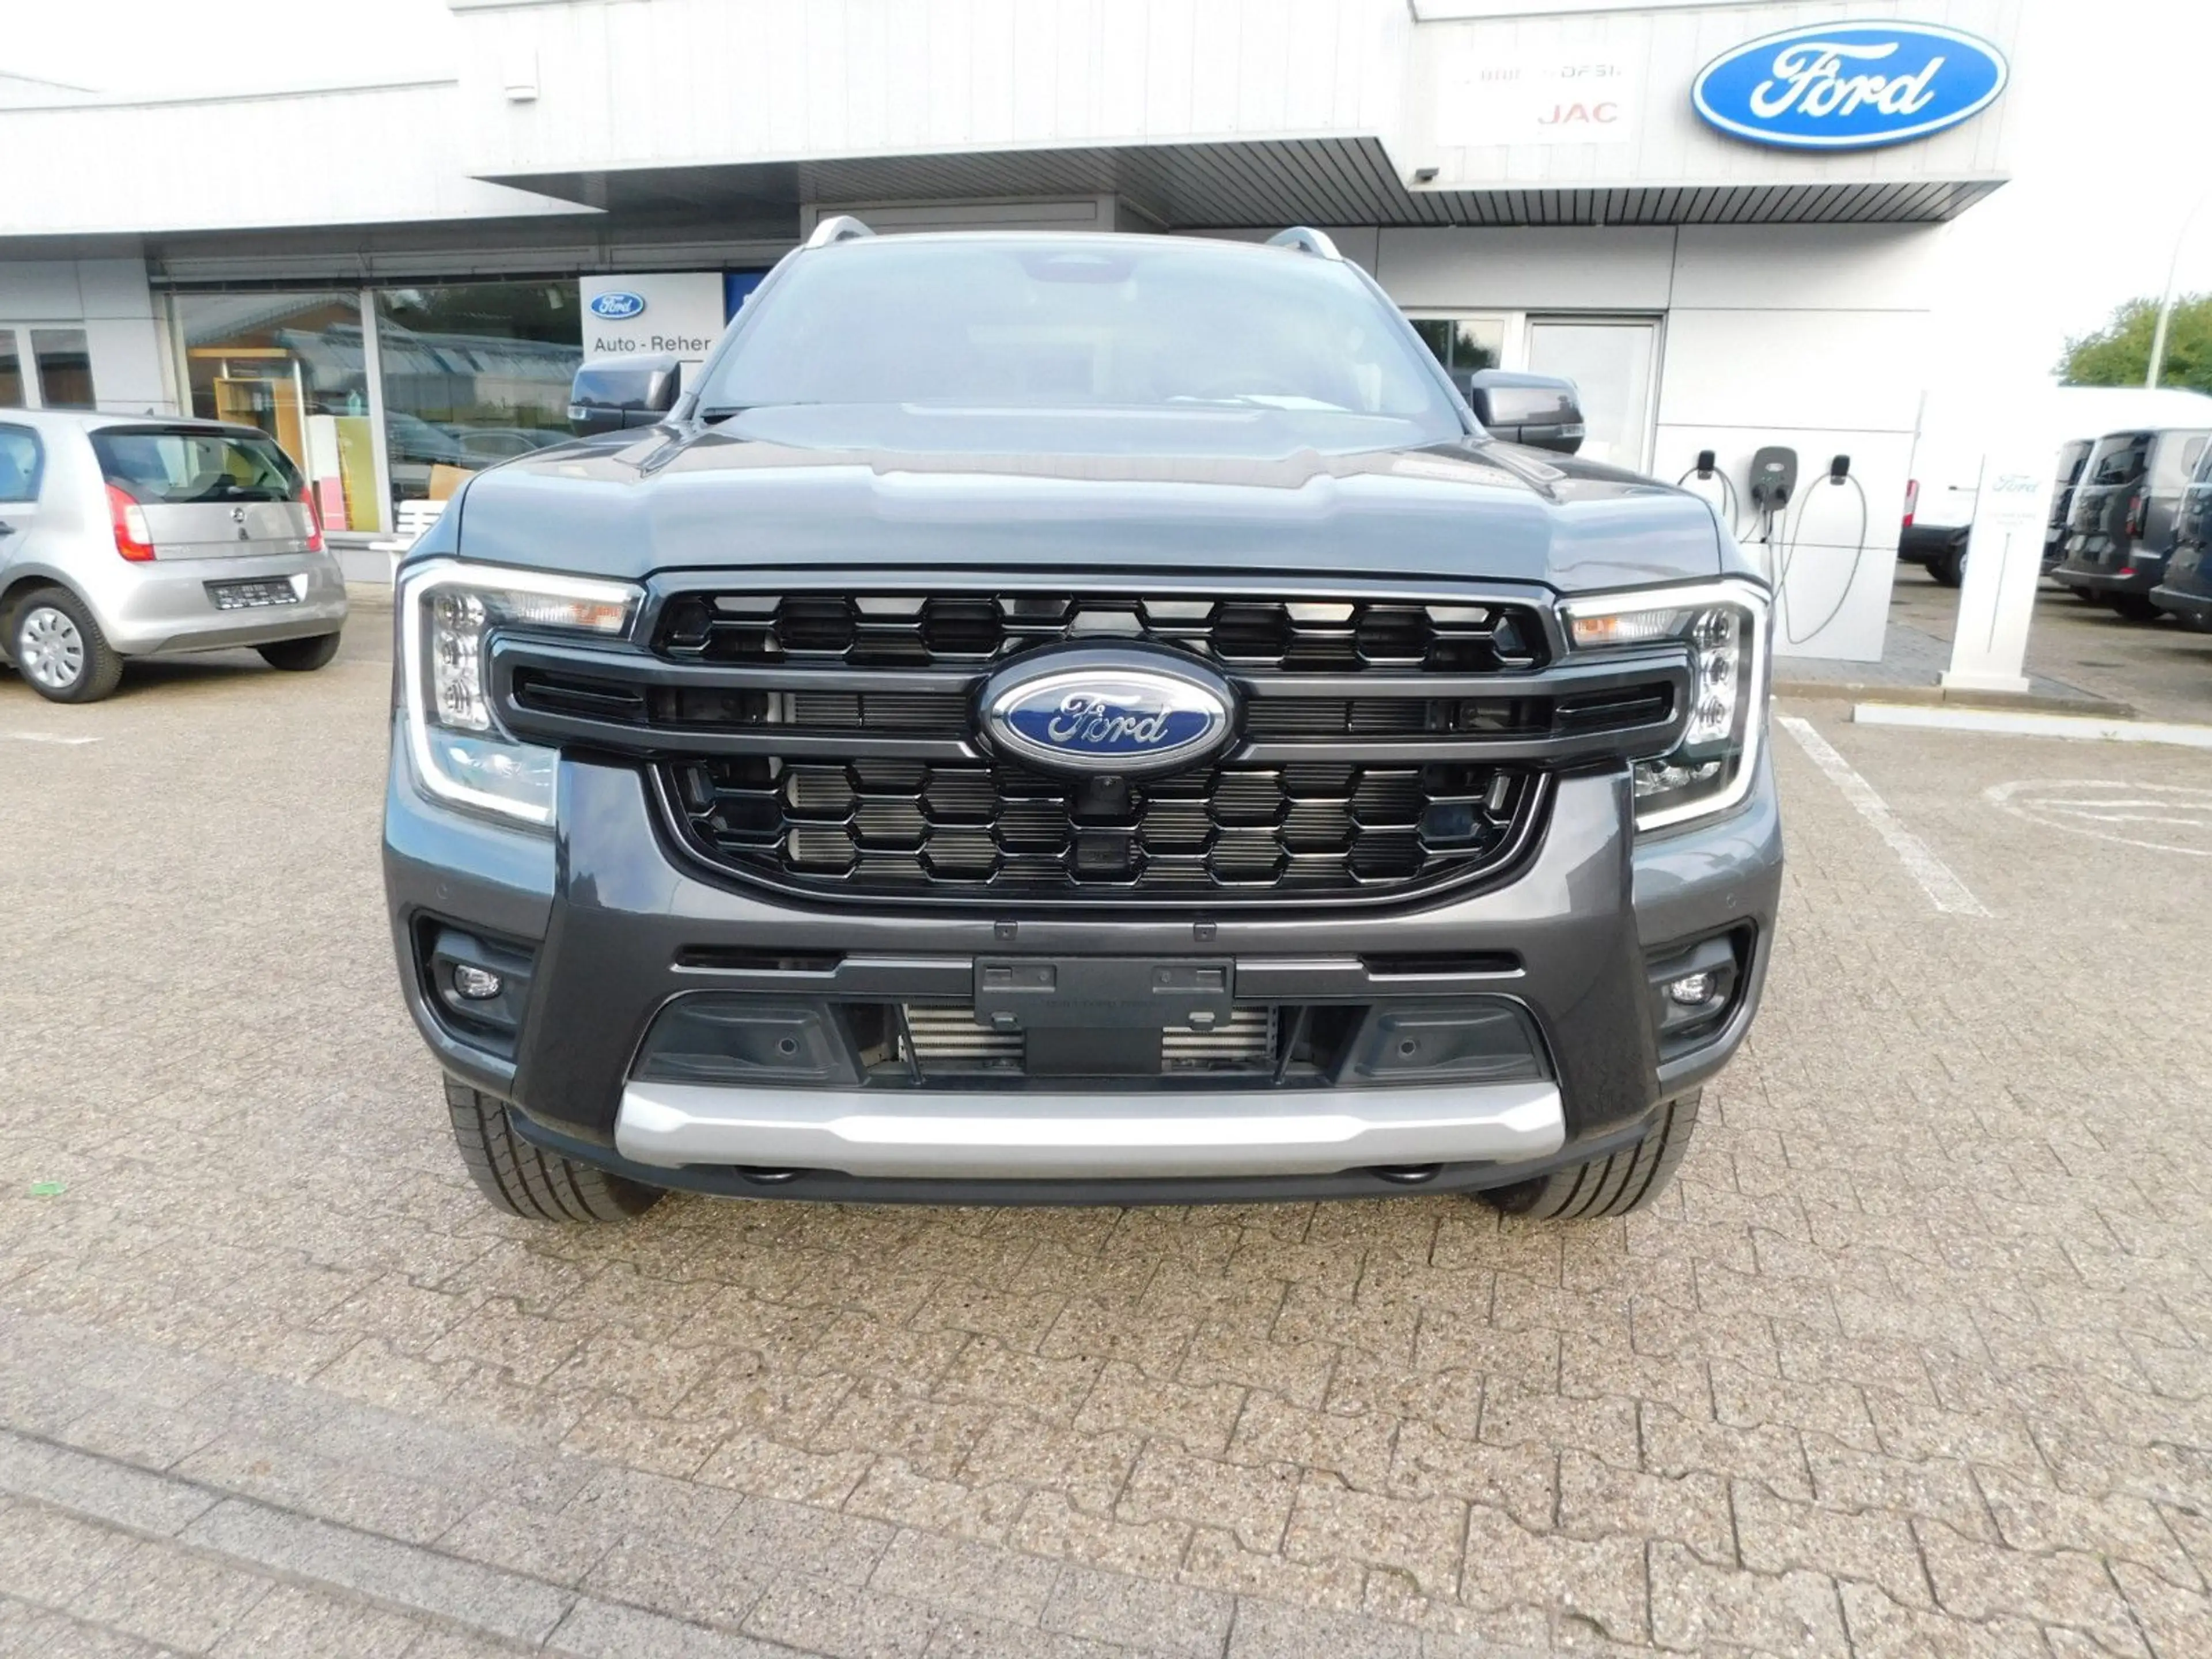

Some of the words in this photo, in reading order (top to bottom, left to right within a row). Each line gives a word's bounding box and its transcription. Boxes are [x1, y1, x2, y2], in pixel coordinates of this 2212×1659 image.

[1750, 42, 1946, 119] Ford
[1537, 101, 1618, 124] JAC
[599, 296, 632, 313] Ford
[594, 337, 636, 352] Auto
[651, 335, 711, 351] Reher
[1992, 474, 2042, 493] Ford
[1048, 692, 1173, 744] Ford
